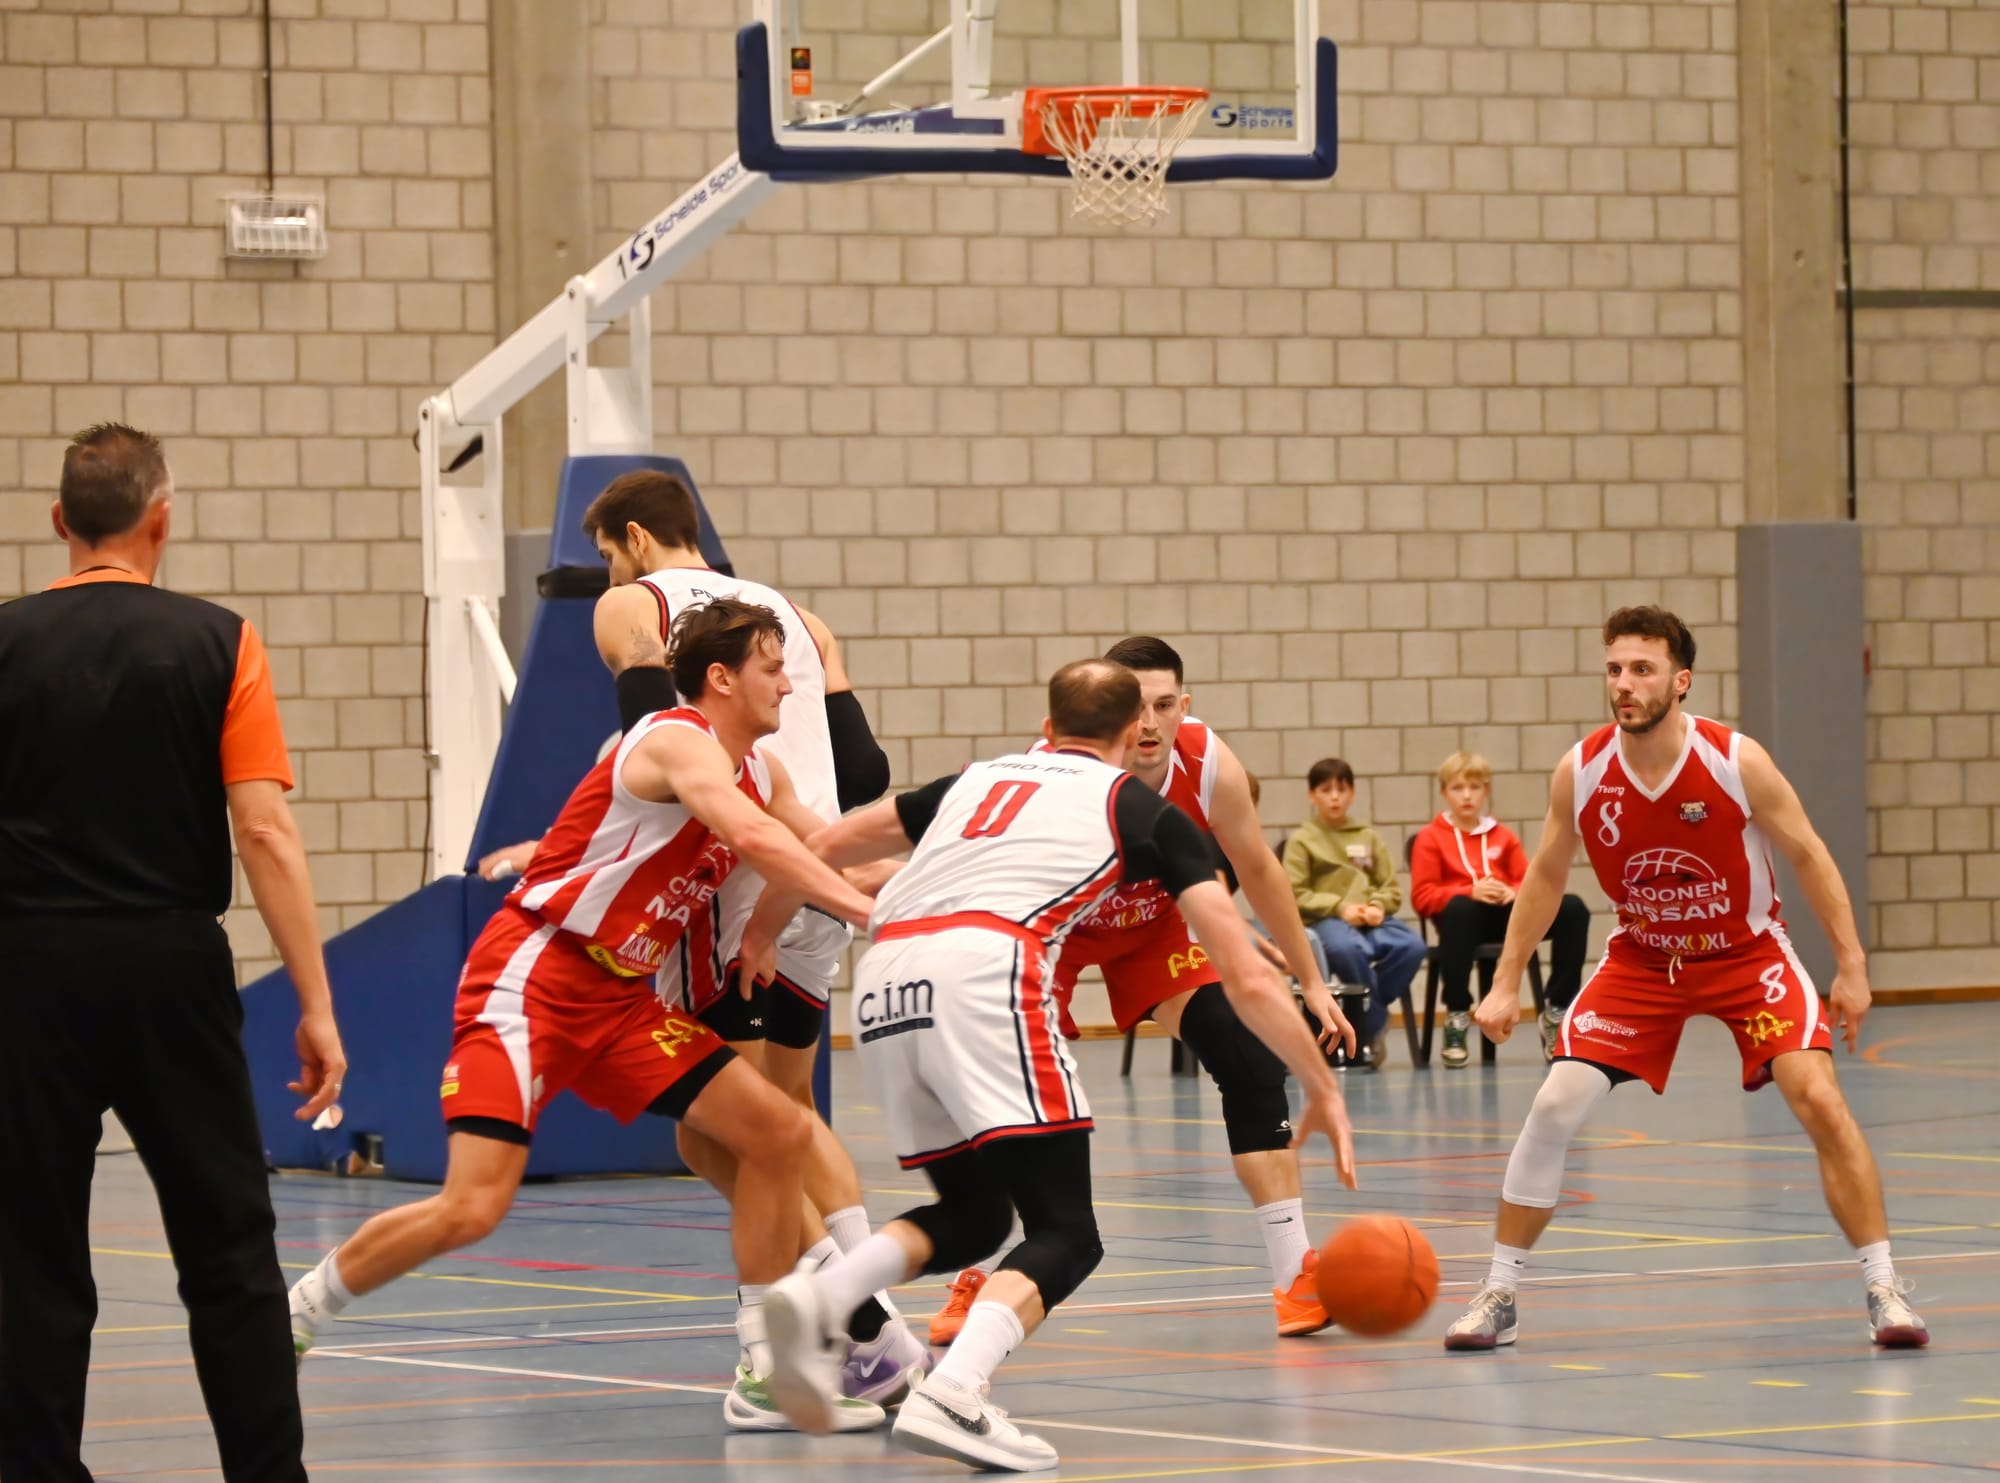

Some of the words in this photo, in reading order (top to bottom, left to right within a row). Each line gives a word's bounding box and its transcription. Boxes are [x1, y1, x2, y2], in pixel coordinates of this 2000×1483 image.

[655, 189, 707, 239] Schelde
[960, 780, 1041, 840] 0
[1597, 801, 1623, 847] 8
[1759, 963, 1787, 1004] 8
